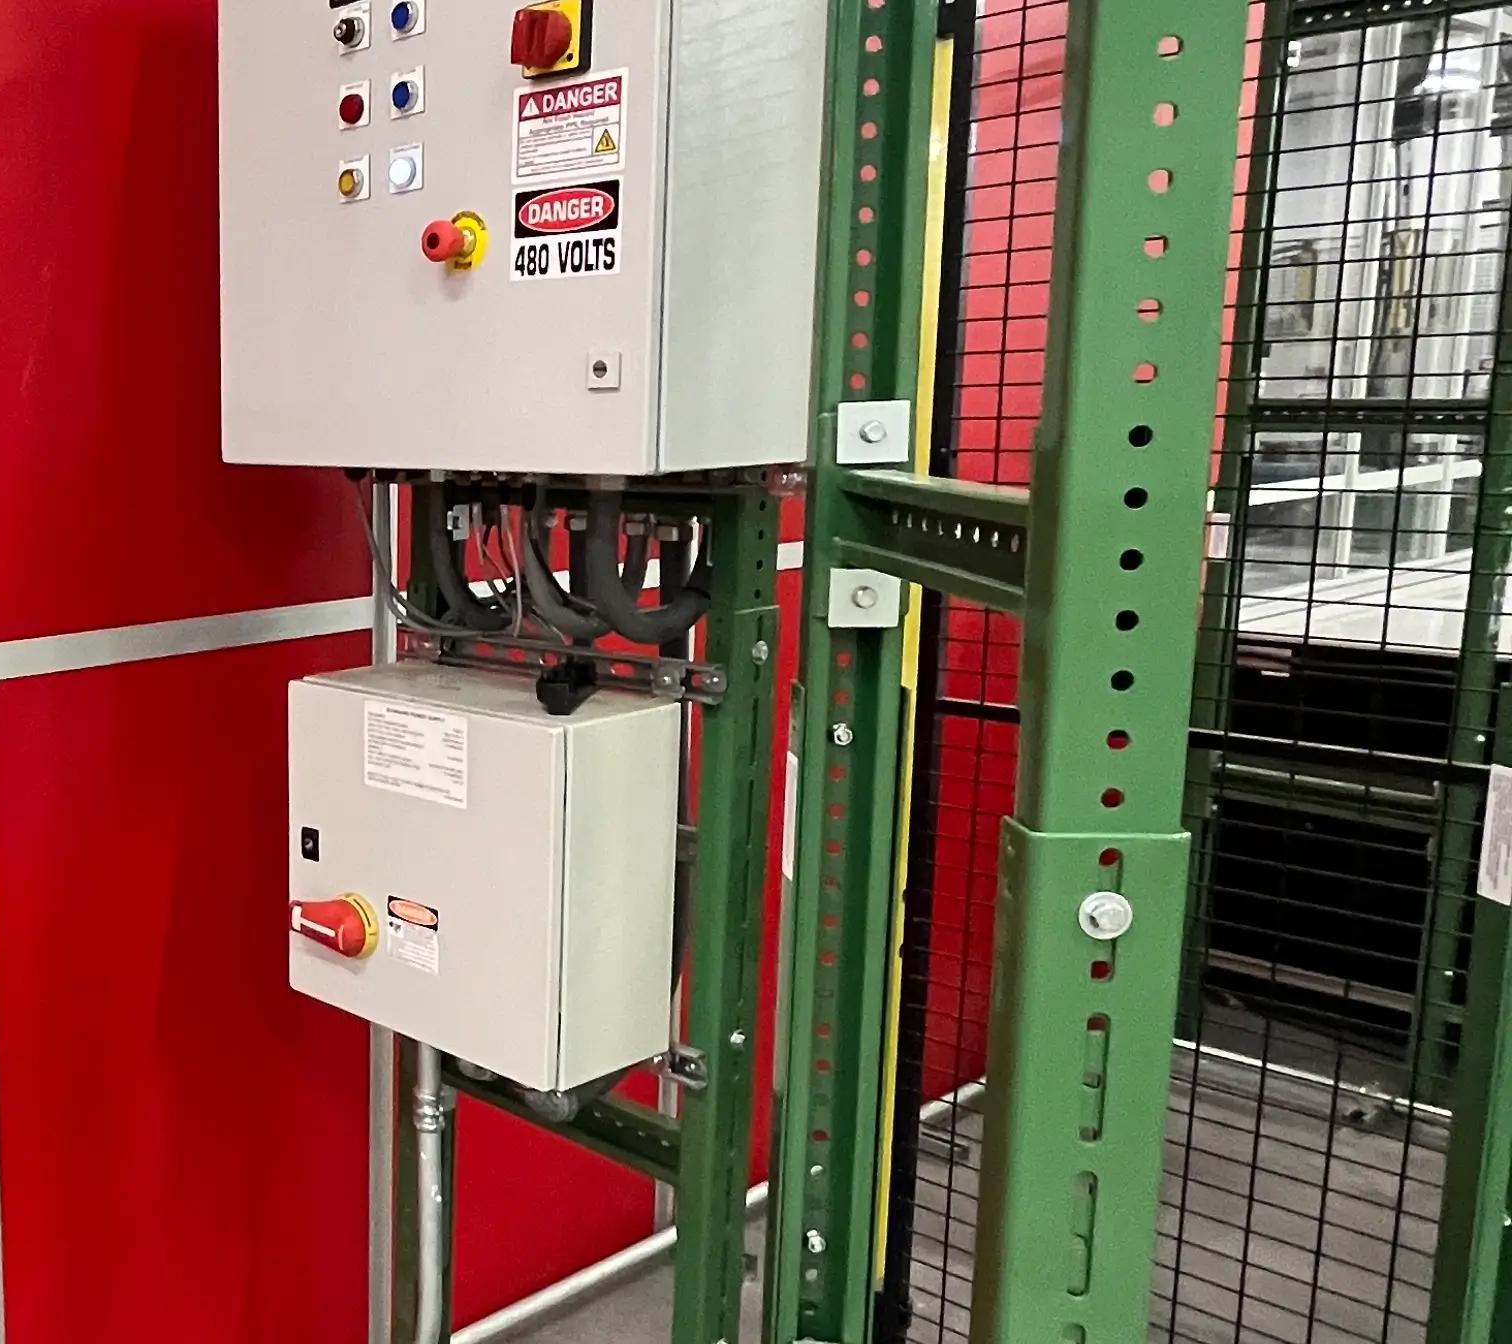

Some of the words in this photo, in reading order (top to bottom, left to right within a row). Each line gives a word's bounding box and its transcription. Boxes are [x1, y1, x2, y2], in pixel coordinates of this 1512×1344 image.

[542, 82, 618, 113] DANGER
[528, 195, 604, 225] DANGER
[514, 243, 549, 277] 480
[558, 237, 615, 274] VOLTS
